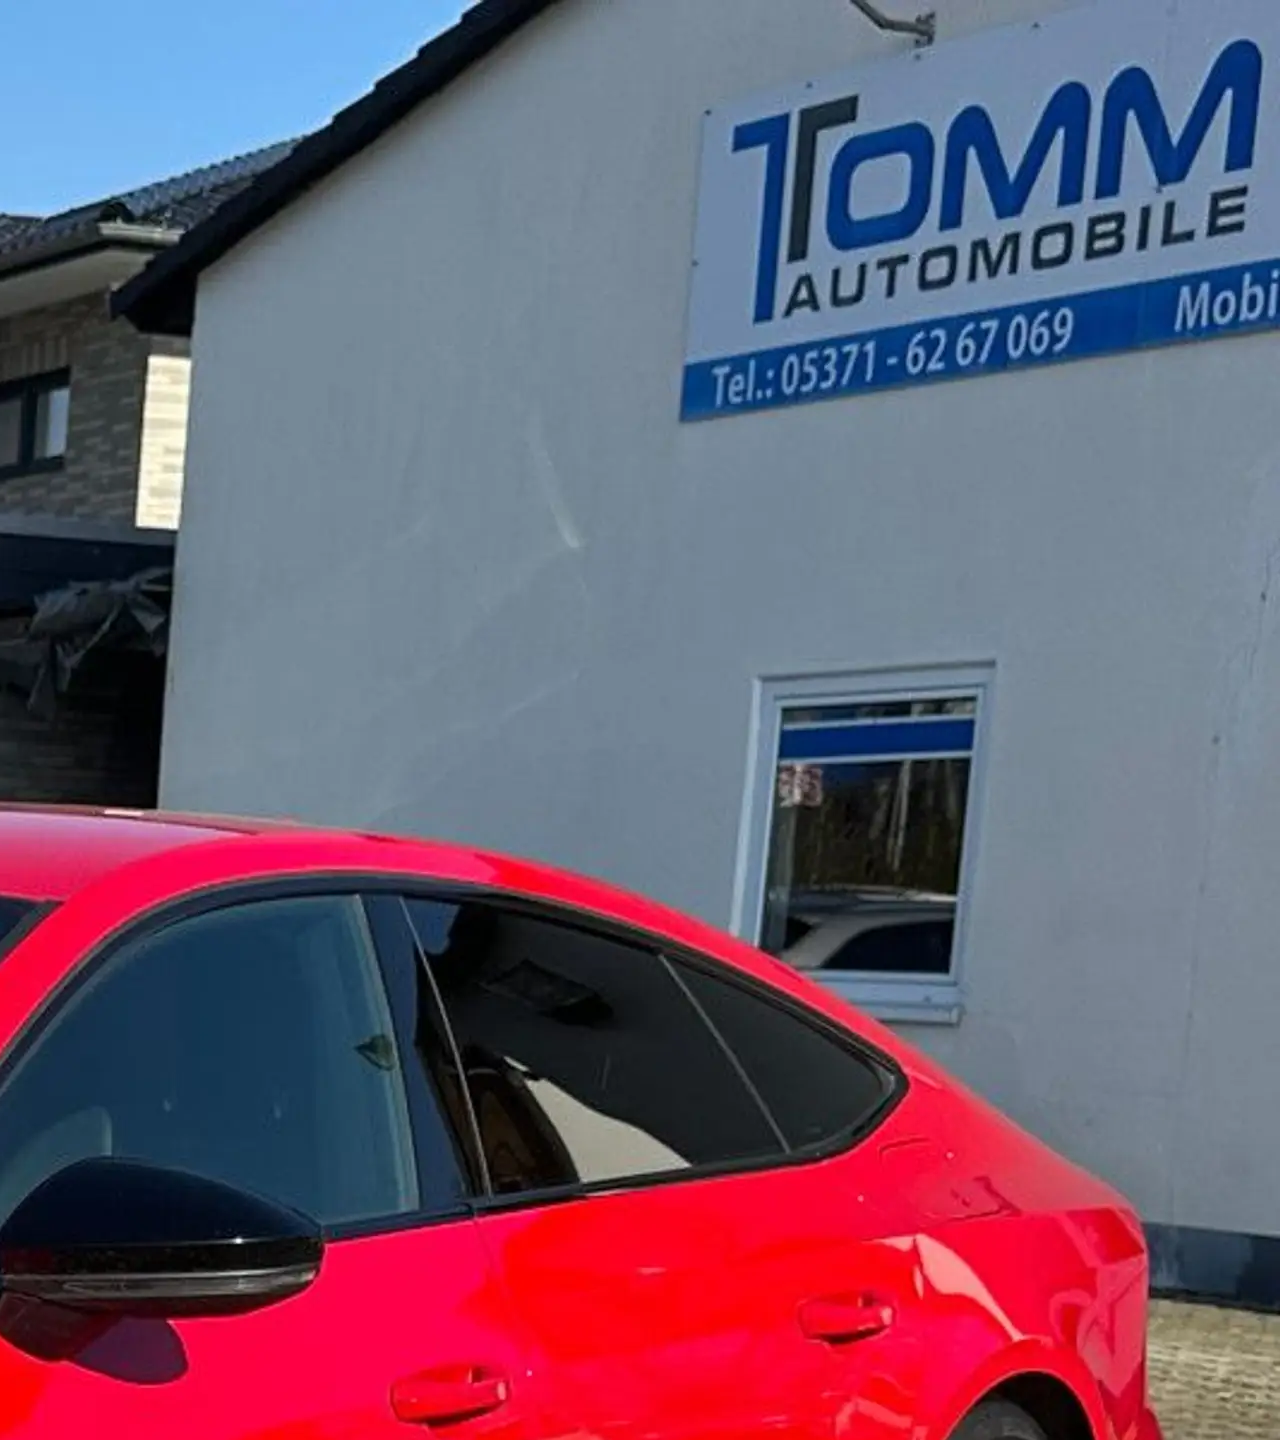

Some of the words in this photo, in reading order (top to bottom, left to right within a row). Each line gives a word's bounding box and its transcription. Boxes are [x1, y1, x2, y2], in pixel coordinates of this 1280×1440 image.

[732, 38, 1263, 325] TOMM
[782, 185, 1249, 319] AUTOMOBILE
[1174, 269, 1280, 333] Mobi
[711, 356, 775, 408] Tel.:
[781, 339, 876, 396] 05371
[906, 328, 948, 376] 62
[956, 319, 1000, 368] 67
[1007, 306, 1075, 361] 069
